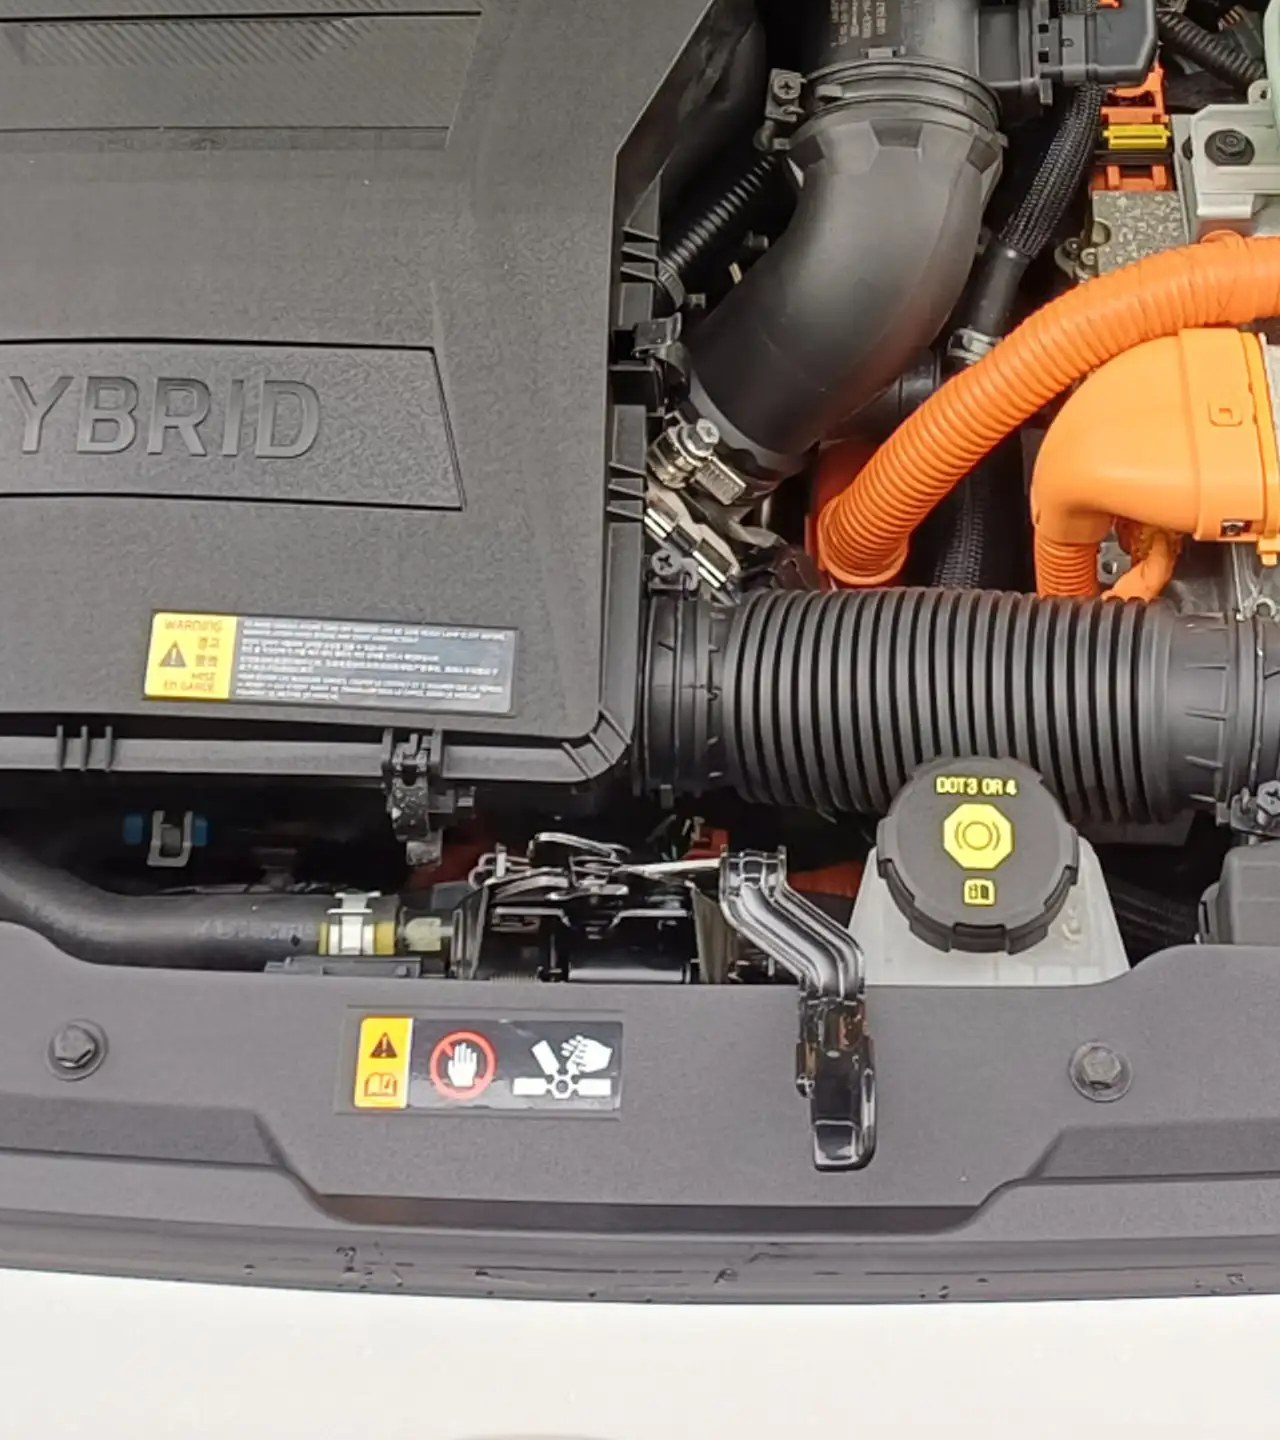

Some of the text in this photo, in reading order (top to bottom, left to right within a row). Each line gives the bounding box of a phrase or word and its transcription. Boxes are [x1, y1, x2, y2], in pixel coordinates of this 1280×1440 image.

[164, 620, 223, 632] WARNING
[982, 777, 1004, 795] OR
[1006, 779, 1018, 795] 4
